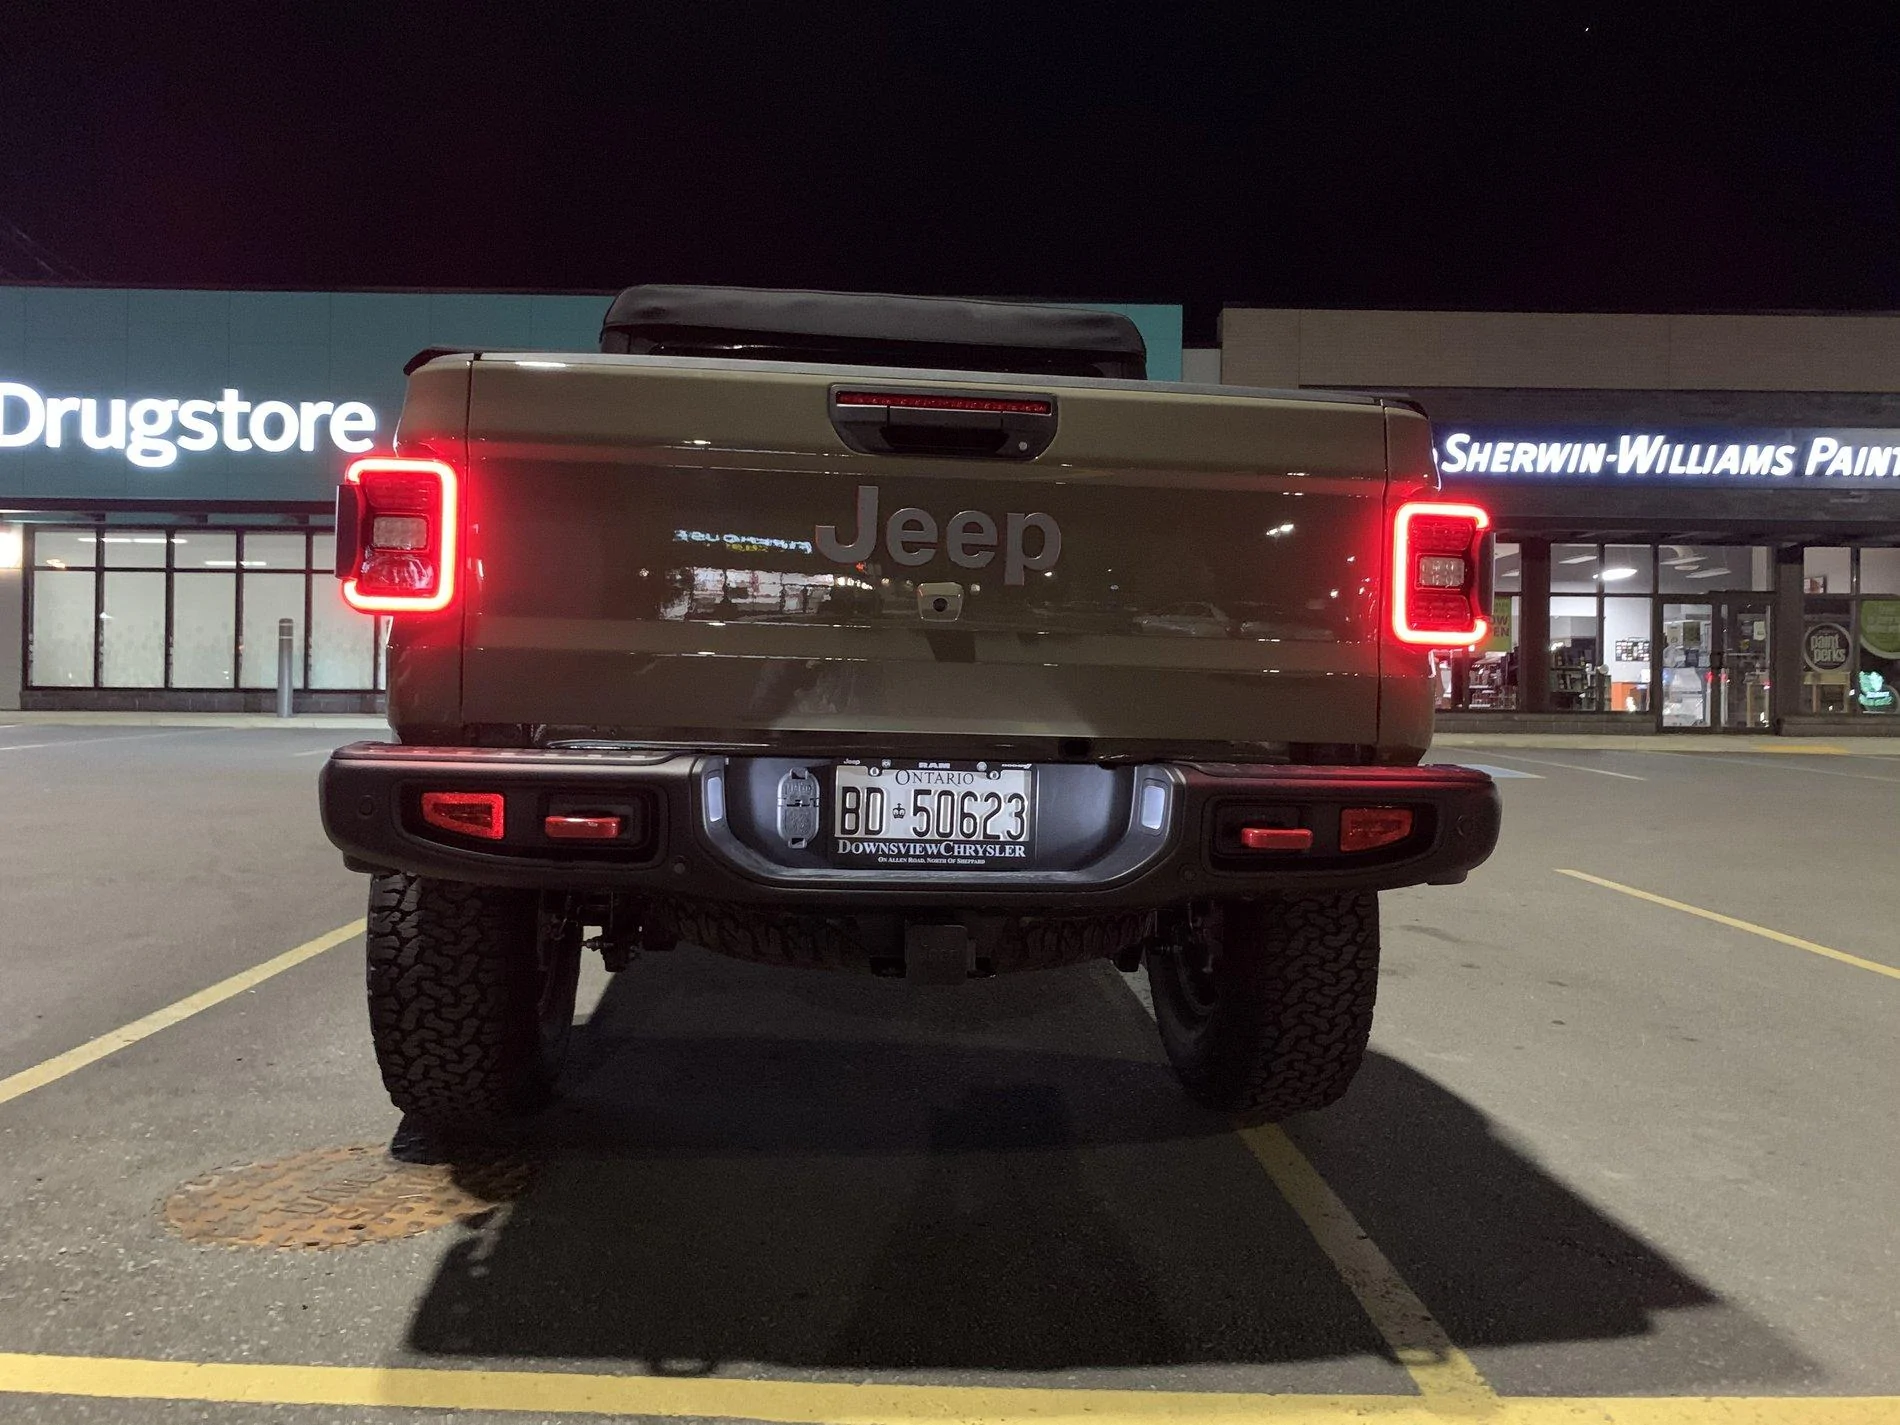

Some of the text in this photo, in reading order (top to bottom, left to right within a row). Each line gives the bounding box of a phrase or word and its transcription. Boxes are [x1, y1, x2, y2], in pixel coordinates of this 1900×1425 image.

[0, 382, 376, 467] Drugstore
[1441, 433, 1796, 476] SHERWIN-WILLIAMS
[815, 485, 1061, 586] Jeep
[1814, 648, 1846, 664] perks
[895, 769, 974, 787] ONTARIO
[840, 786, 1026, 841] BD 50623
